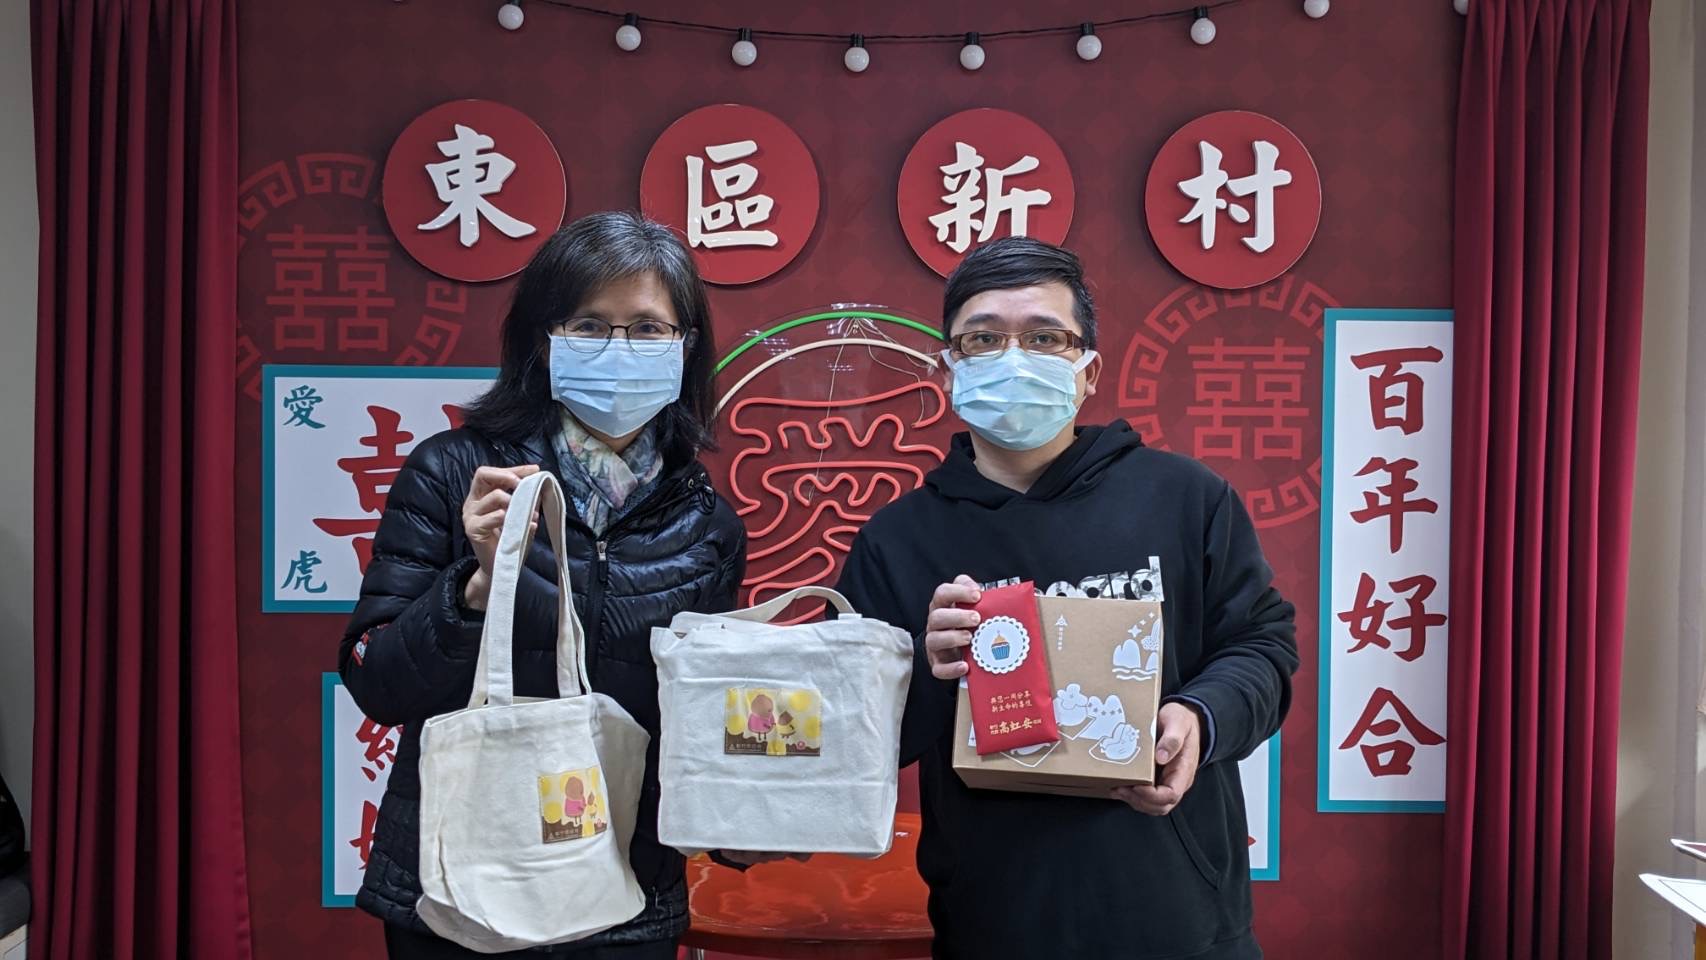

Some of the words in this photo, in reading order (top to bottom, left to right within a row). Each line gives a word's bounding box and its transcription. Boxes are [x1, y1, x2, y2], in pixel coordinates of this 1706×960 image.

[418, 123, 1293, 254] 東區新村
[283, 385, 326, 430] 愛
[281, 550, 327, 594] 虎
[1338, 346, 1447, 777] 百年好合
